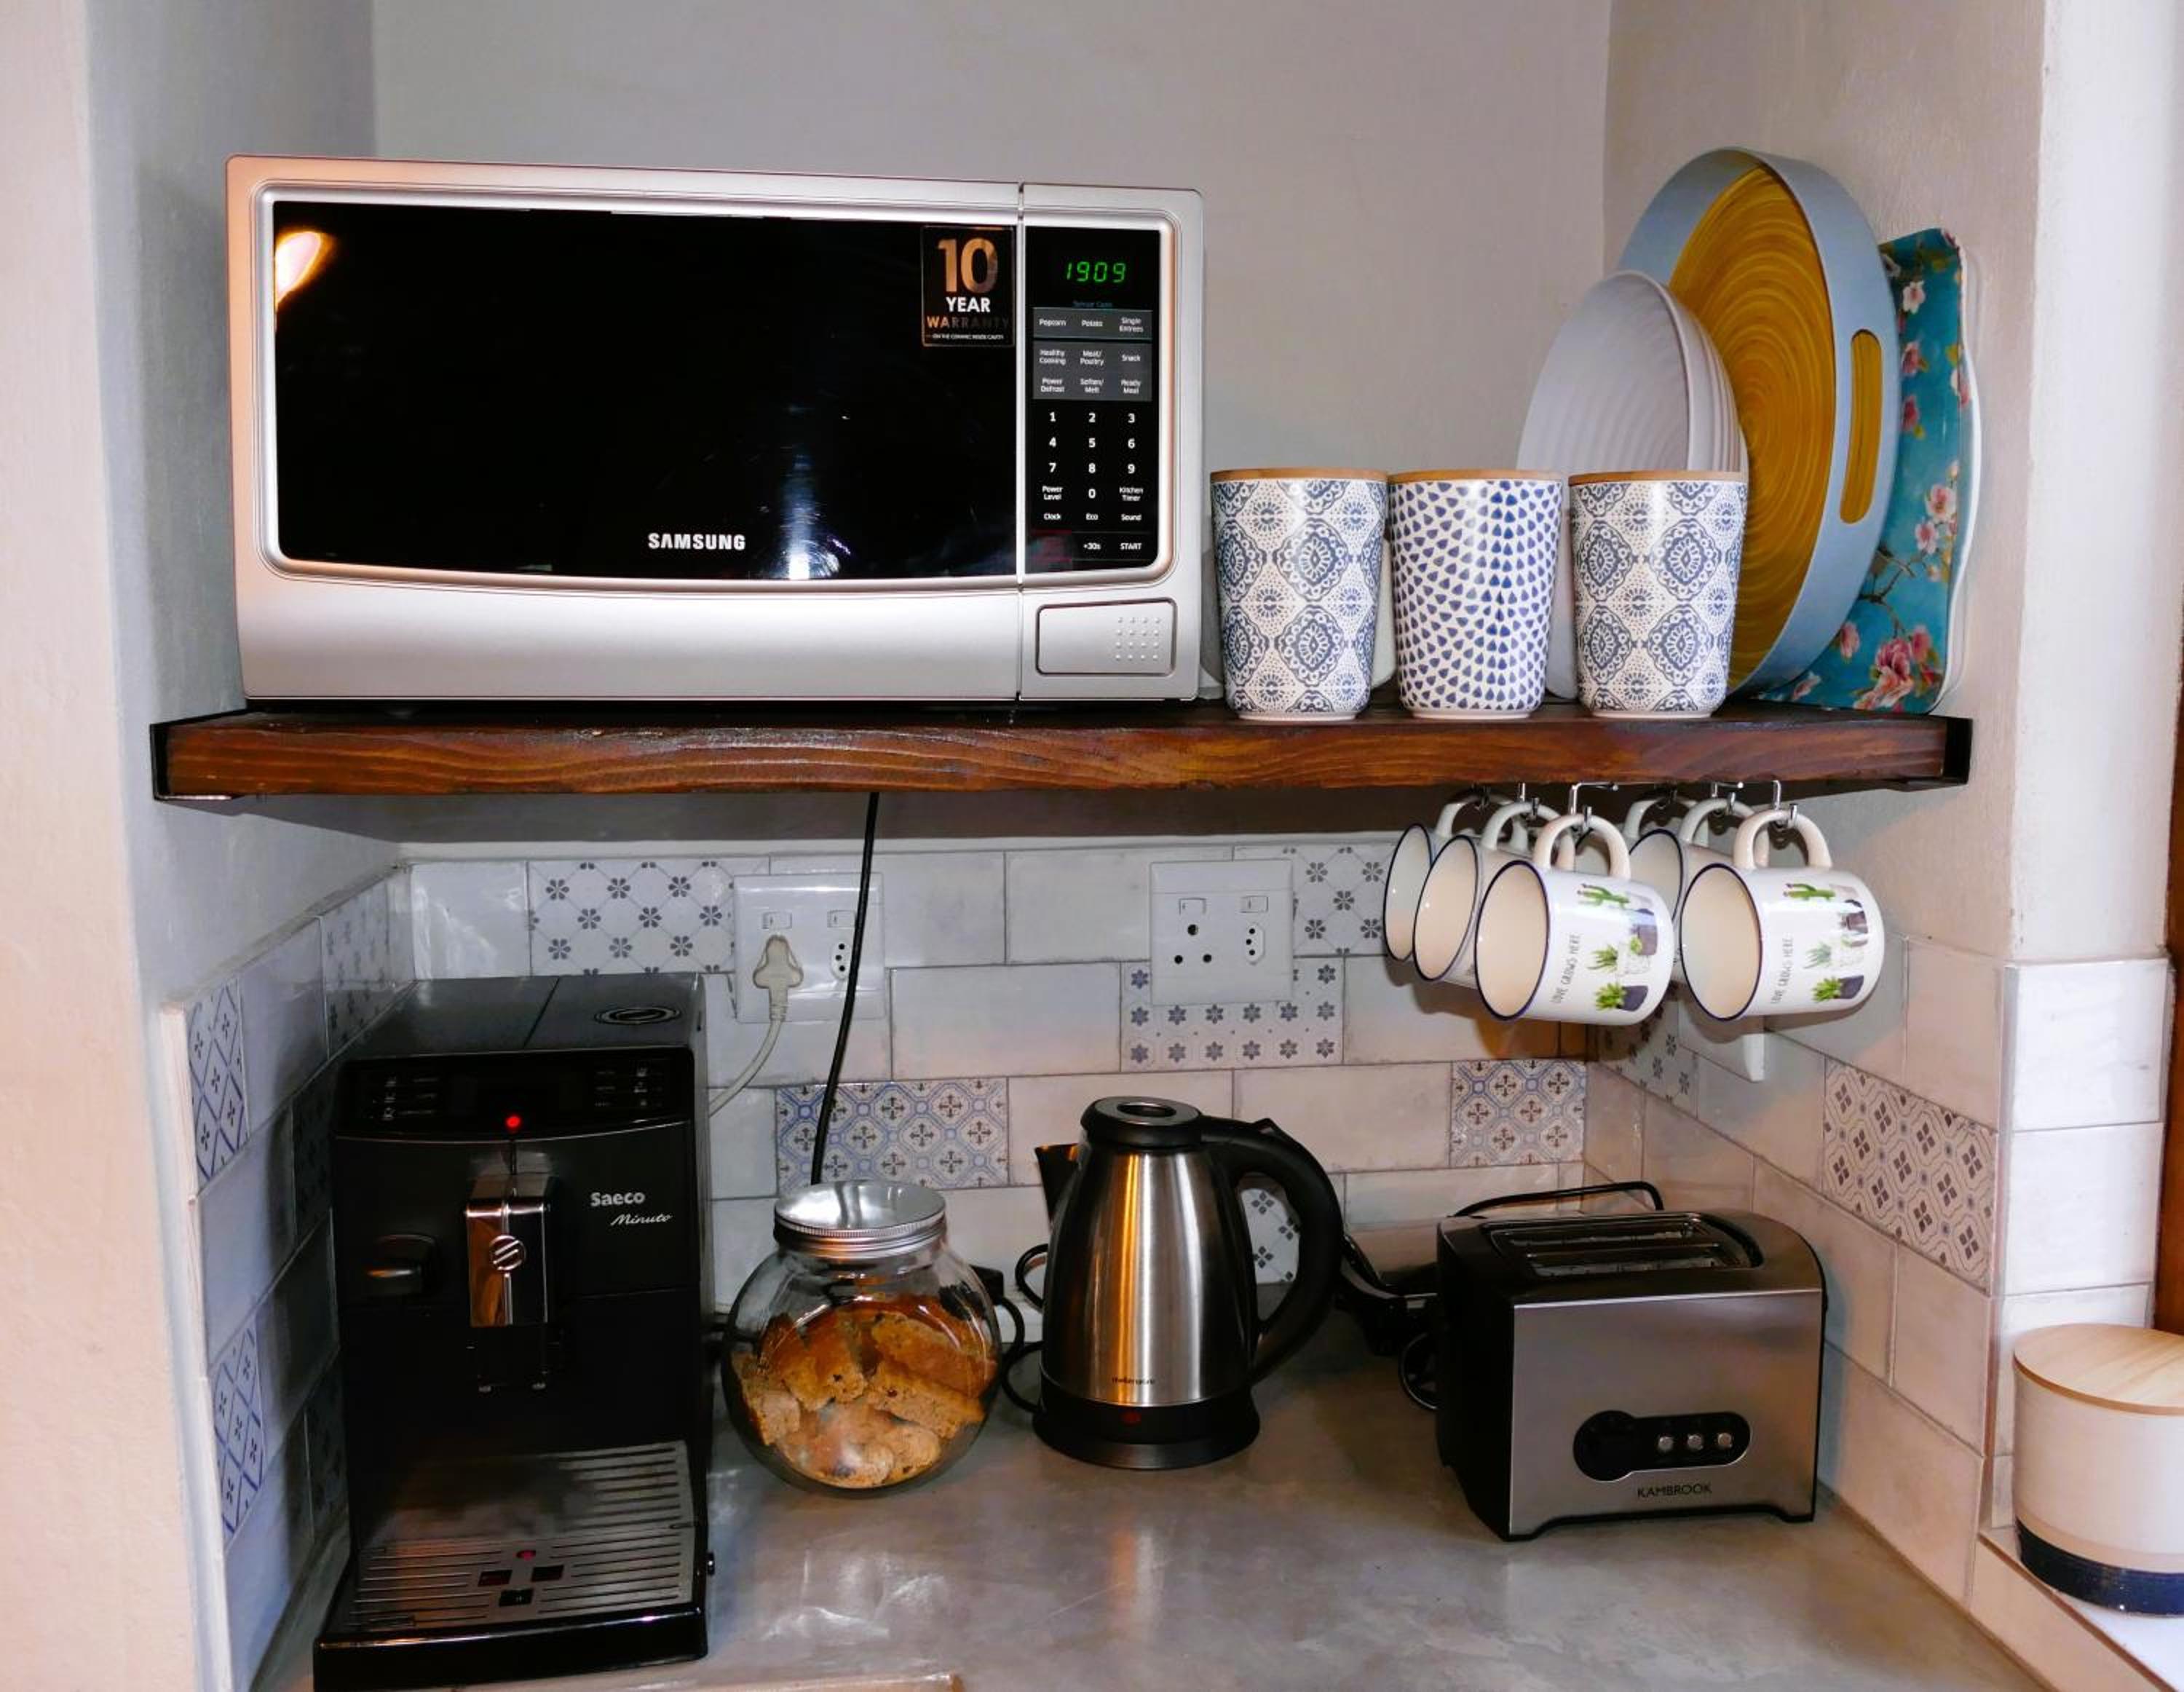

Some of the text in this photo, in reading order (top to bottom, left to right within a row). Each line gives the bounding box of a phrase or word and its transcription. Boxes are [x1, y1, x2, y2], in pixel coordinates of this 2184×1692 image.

[937, 238, 998, 293] 10
[1067, 261, 1126, 282] 1909
[946, 297, 991, 312] YEAR
[1039, 318, 1067, 327] Popcorn
[1049, 411, 1056, 422] 1
[1088, 412, 1096, 423] 2
[1128, 413, 1135, 423] 3
[1049, 437, 1056, 447] 4
[1088, 438, 1096, 448] 5
[1128, 438, 1135, 448] 6
[1048, 462, 1056, 473] 7
[1088, 462, 1096, 473] 8
[1128, 464, 1135, 474] 9
[1088, 489, 1096, 499] 0
[648, 532, 746, 550] SAMSUNG
[590, 1192, 646, 1206] Saeco
[610, 1213, 673, 1226] Minuto
[1637, 1483, 1713, 1498] KAMBROOK
